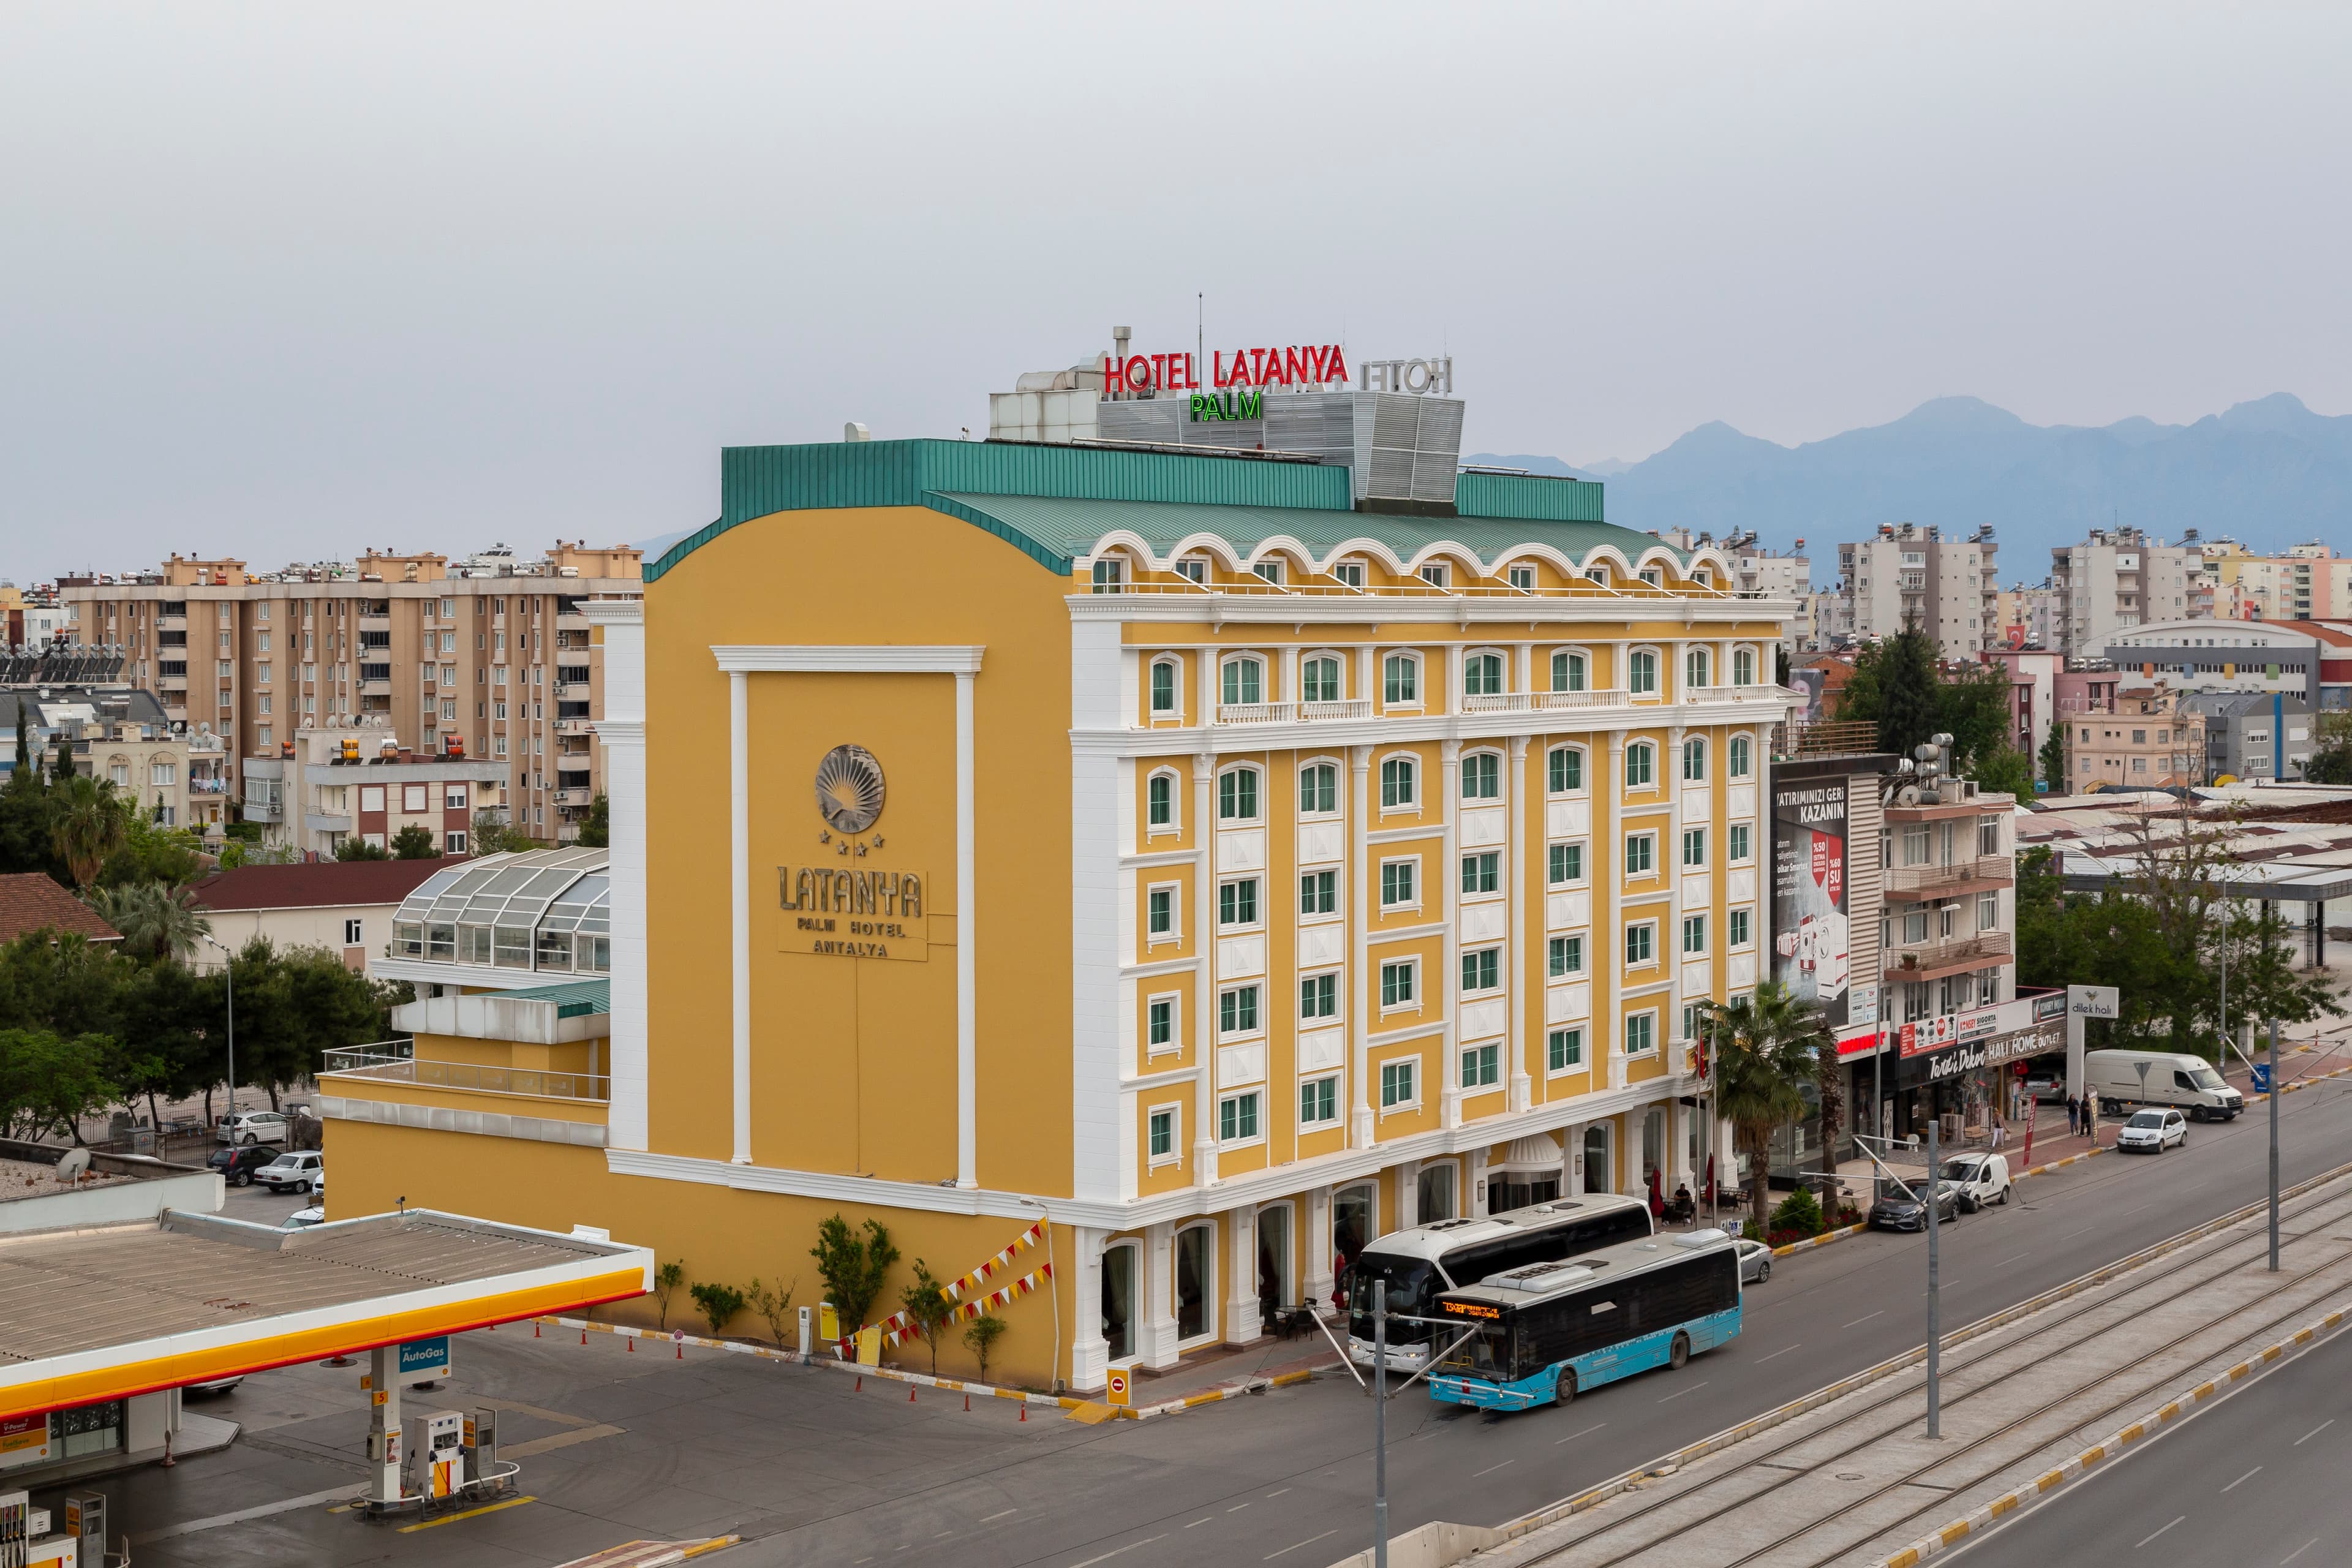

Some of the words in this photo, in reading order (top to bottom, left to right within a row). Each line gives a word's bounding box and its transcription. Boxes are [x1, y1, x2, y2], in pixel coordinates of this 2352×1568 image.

[1106, 352, 1200, 393] HOTEL
[1214, 345, 1350, 387] LATANYA
[1191, 391, 1262, 422] PALM
[1801, 802, 1844, 823] KAZANIN
[1813, 842, 1825, 853] %50
[1777, 864, 1789, 874] olkar
[1830, 858, 1841, 869] %60
[1830, 869, 1840, 884] SU
[777, 866, 921, 918] LATANYA
[797, 918, 835, 932] PALM
[851, 921, 905, 937] HOTEL
[813, 940, 887, 957] ANTALYA
[2073, 1003, 2093, 1014] dilek
[1989, 1041, 2008, 1060] HALI
[2012, 1033, 2037, 1054] HOME
[2038, 1032, 2060, 1047] OUTLET
[1959, 1044, 1986, 1072] Dekor
[402, 1348, 444, 1363] AutoGas
[379, 1393, 384, 1402] 5
[4, 1422, 28, 1431] V-Power
